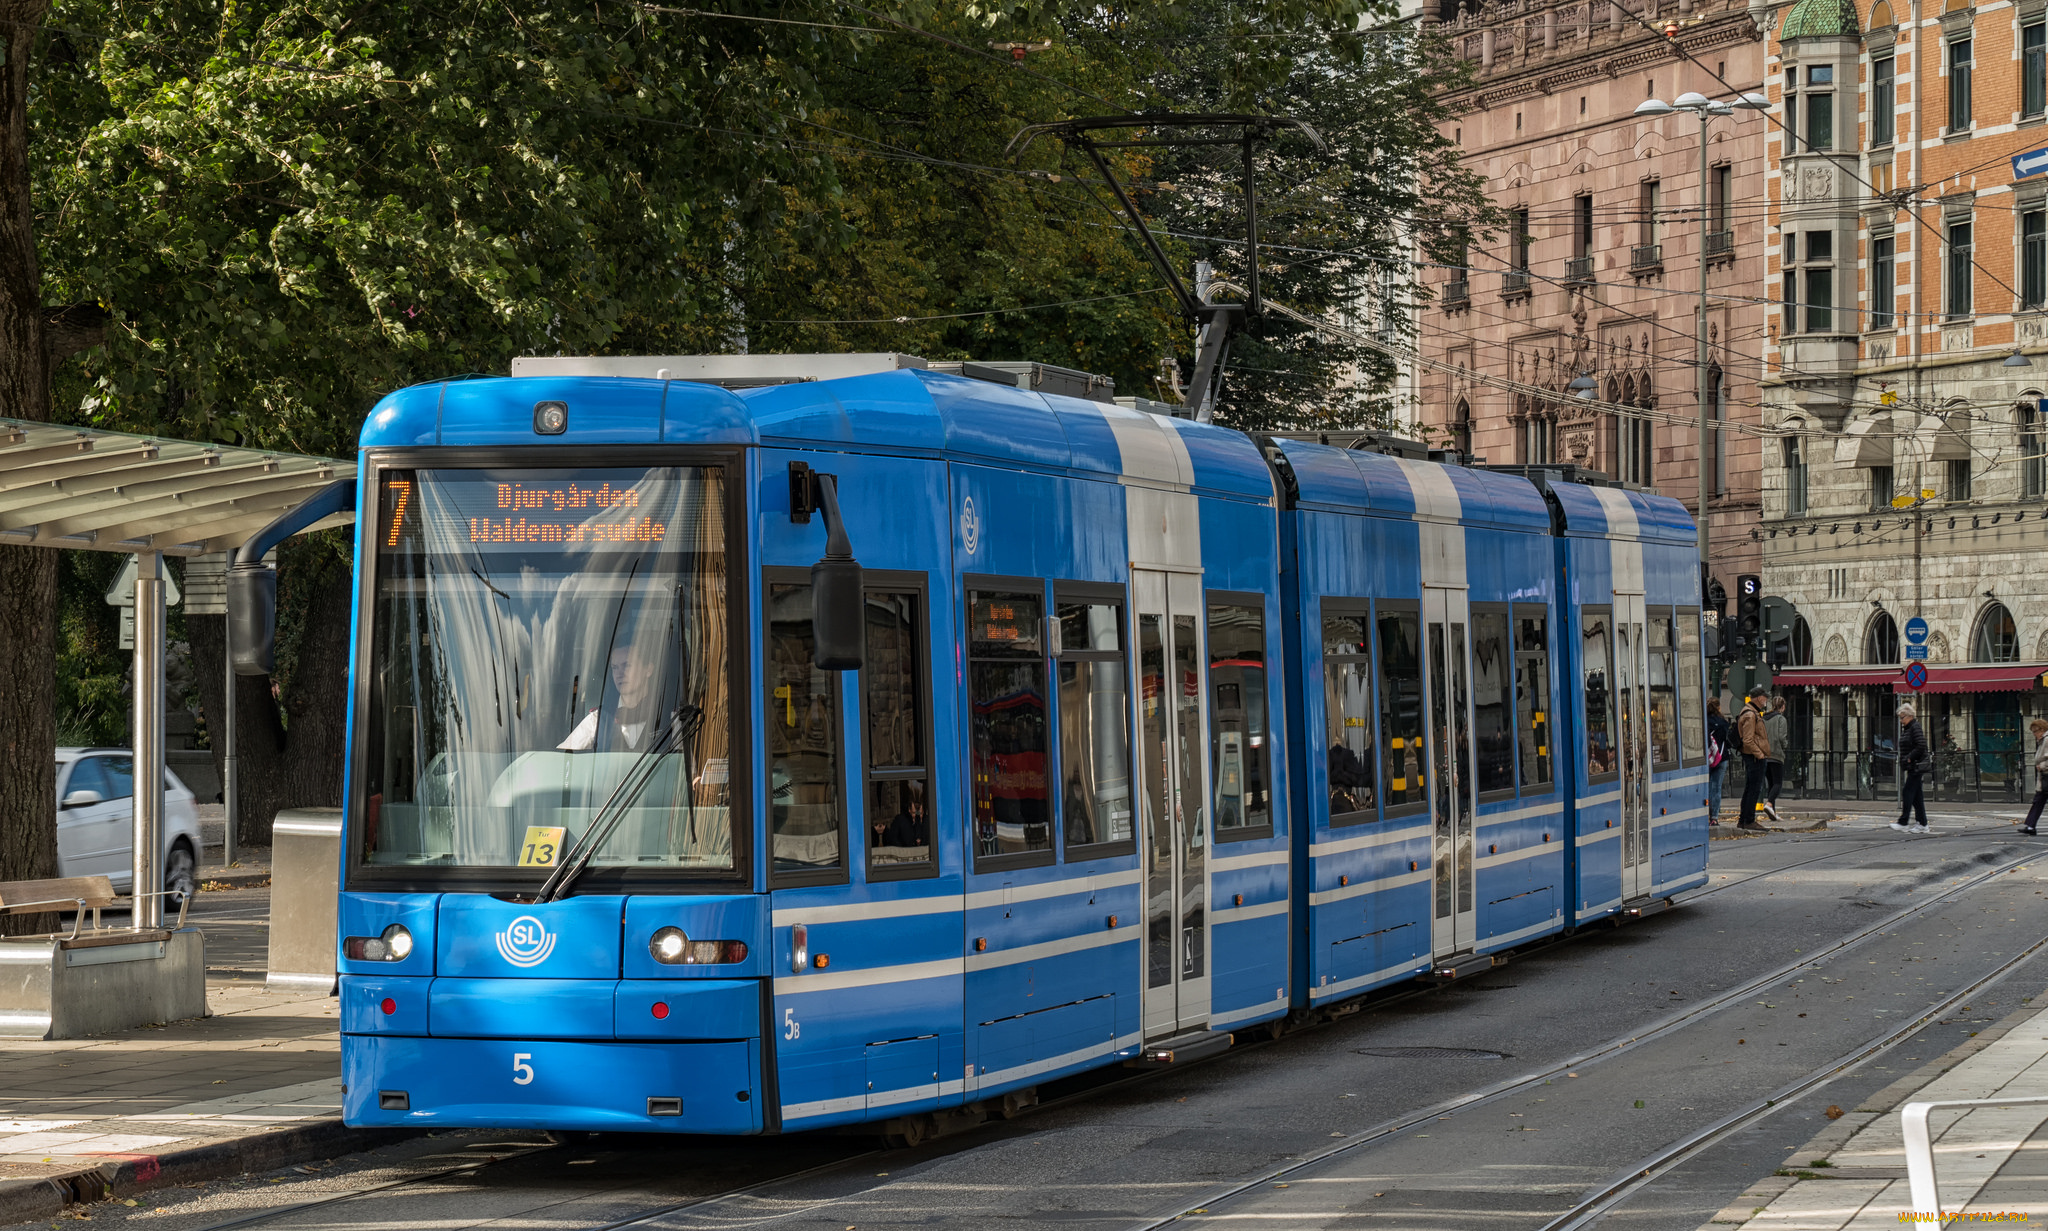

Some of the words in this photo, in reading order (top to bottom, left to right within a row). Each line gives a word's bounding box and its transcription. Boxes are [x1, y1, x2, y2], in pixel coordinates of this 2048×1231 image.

[497, 483, 639, 511] Djurgården
[388, 481, 410, 546] 7
[966, 507, 974, 529] SL
[470, 517, 666, 543] Waldemarsudde
[1744, 580, 1755, 594] S
[526, 843, 554, 865] 13
[513, 925, 539, 945] SL
[513, 1053, 534, 1085] 5
